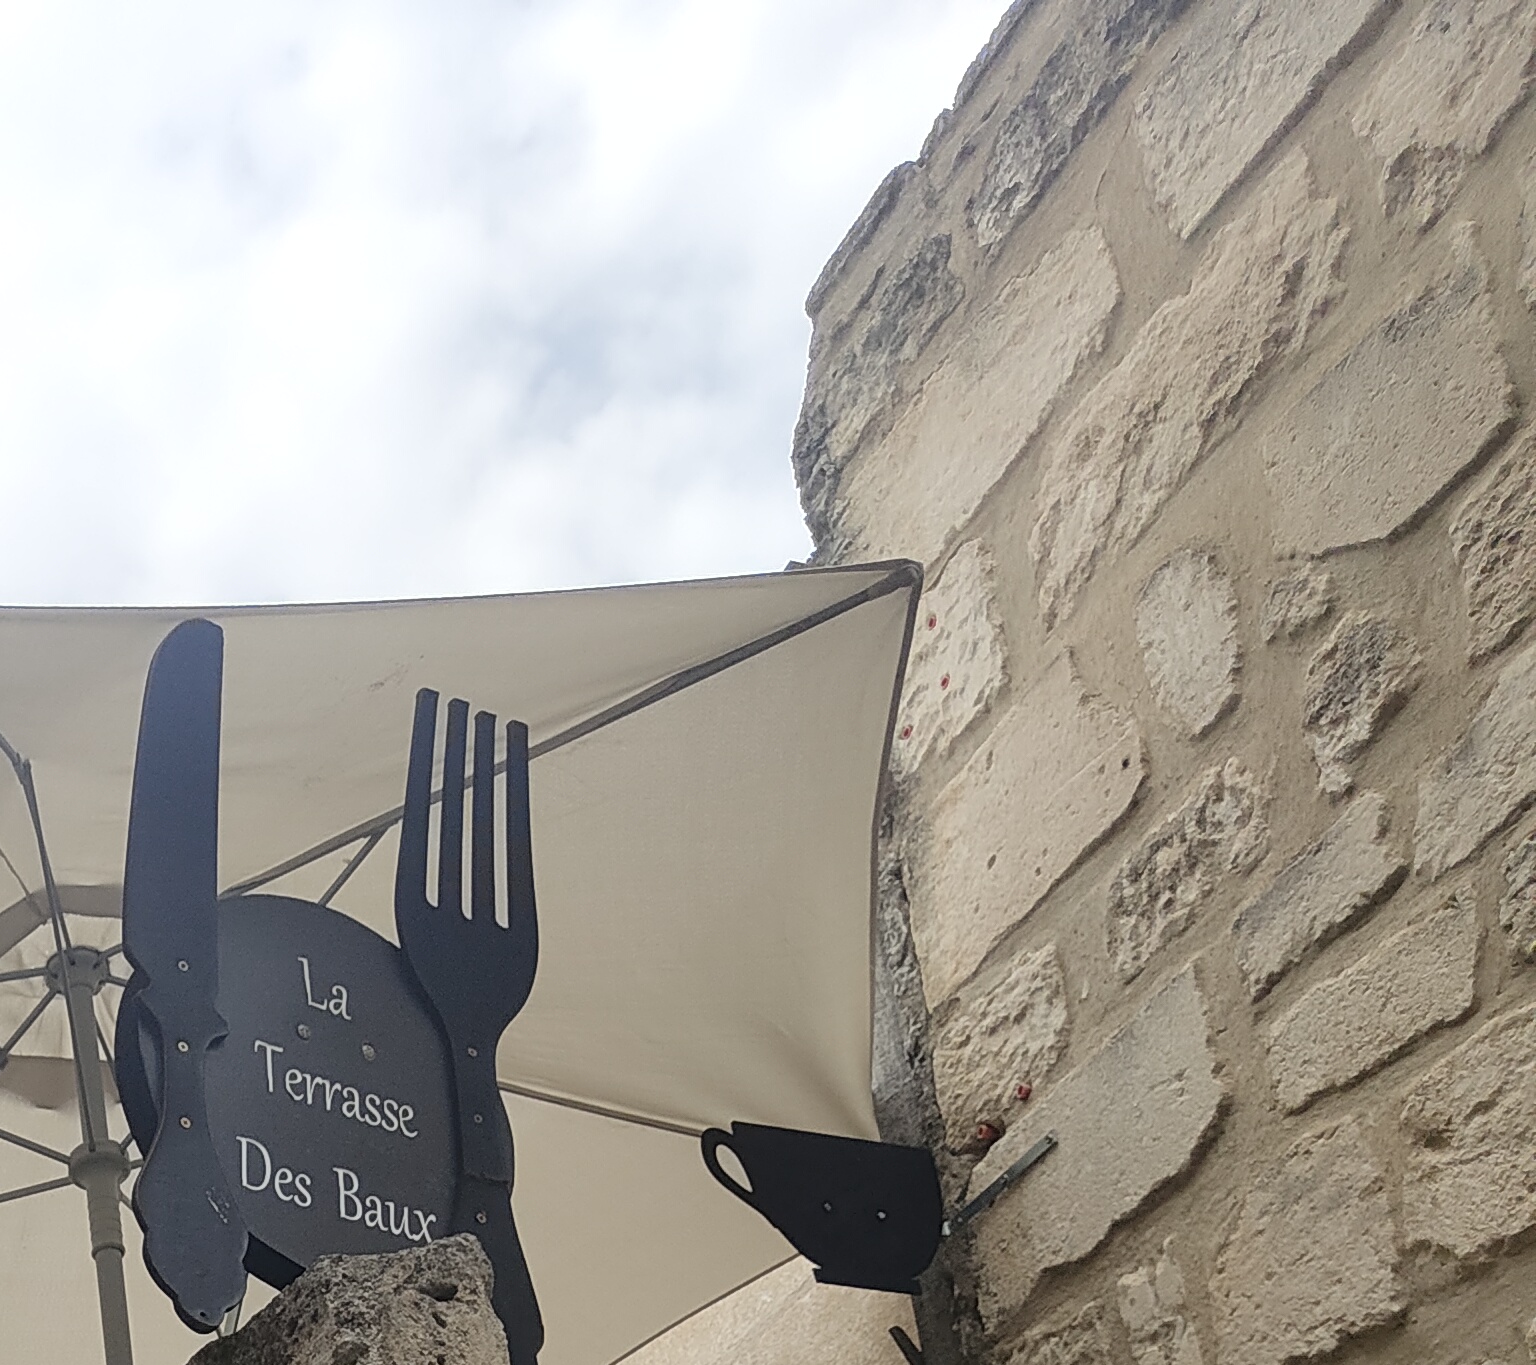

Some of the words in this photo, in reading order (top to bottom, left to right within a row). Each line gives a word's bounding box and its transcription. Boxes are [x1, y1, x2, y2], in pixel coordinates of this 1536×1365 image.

[297, 956, 352, 1021] La
[254, 1039, 419, 1138] Terrasse
[235, 1135, 313, 1208] Des
[332, 1166, 437, 1244] Baux
